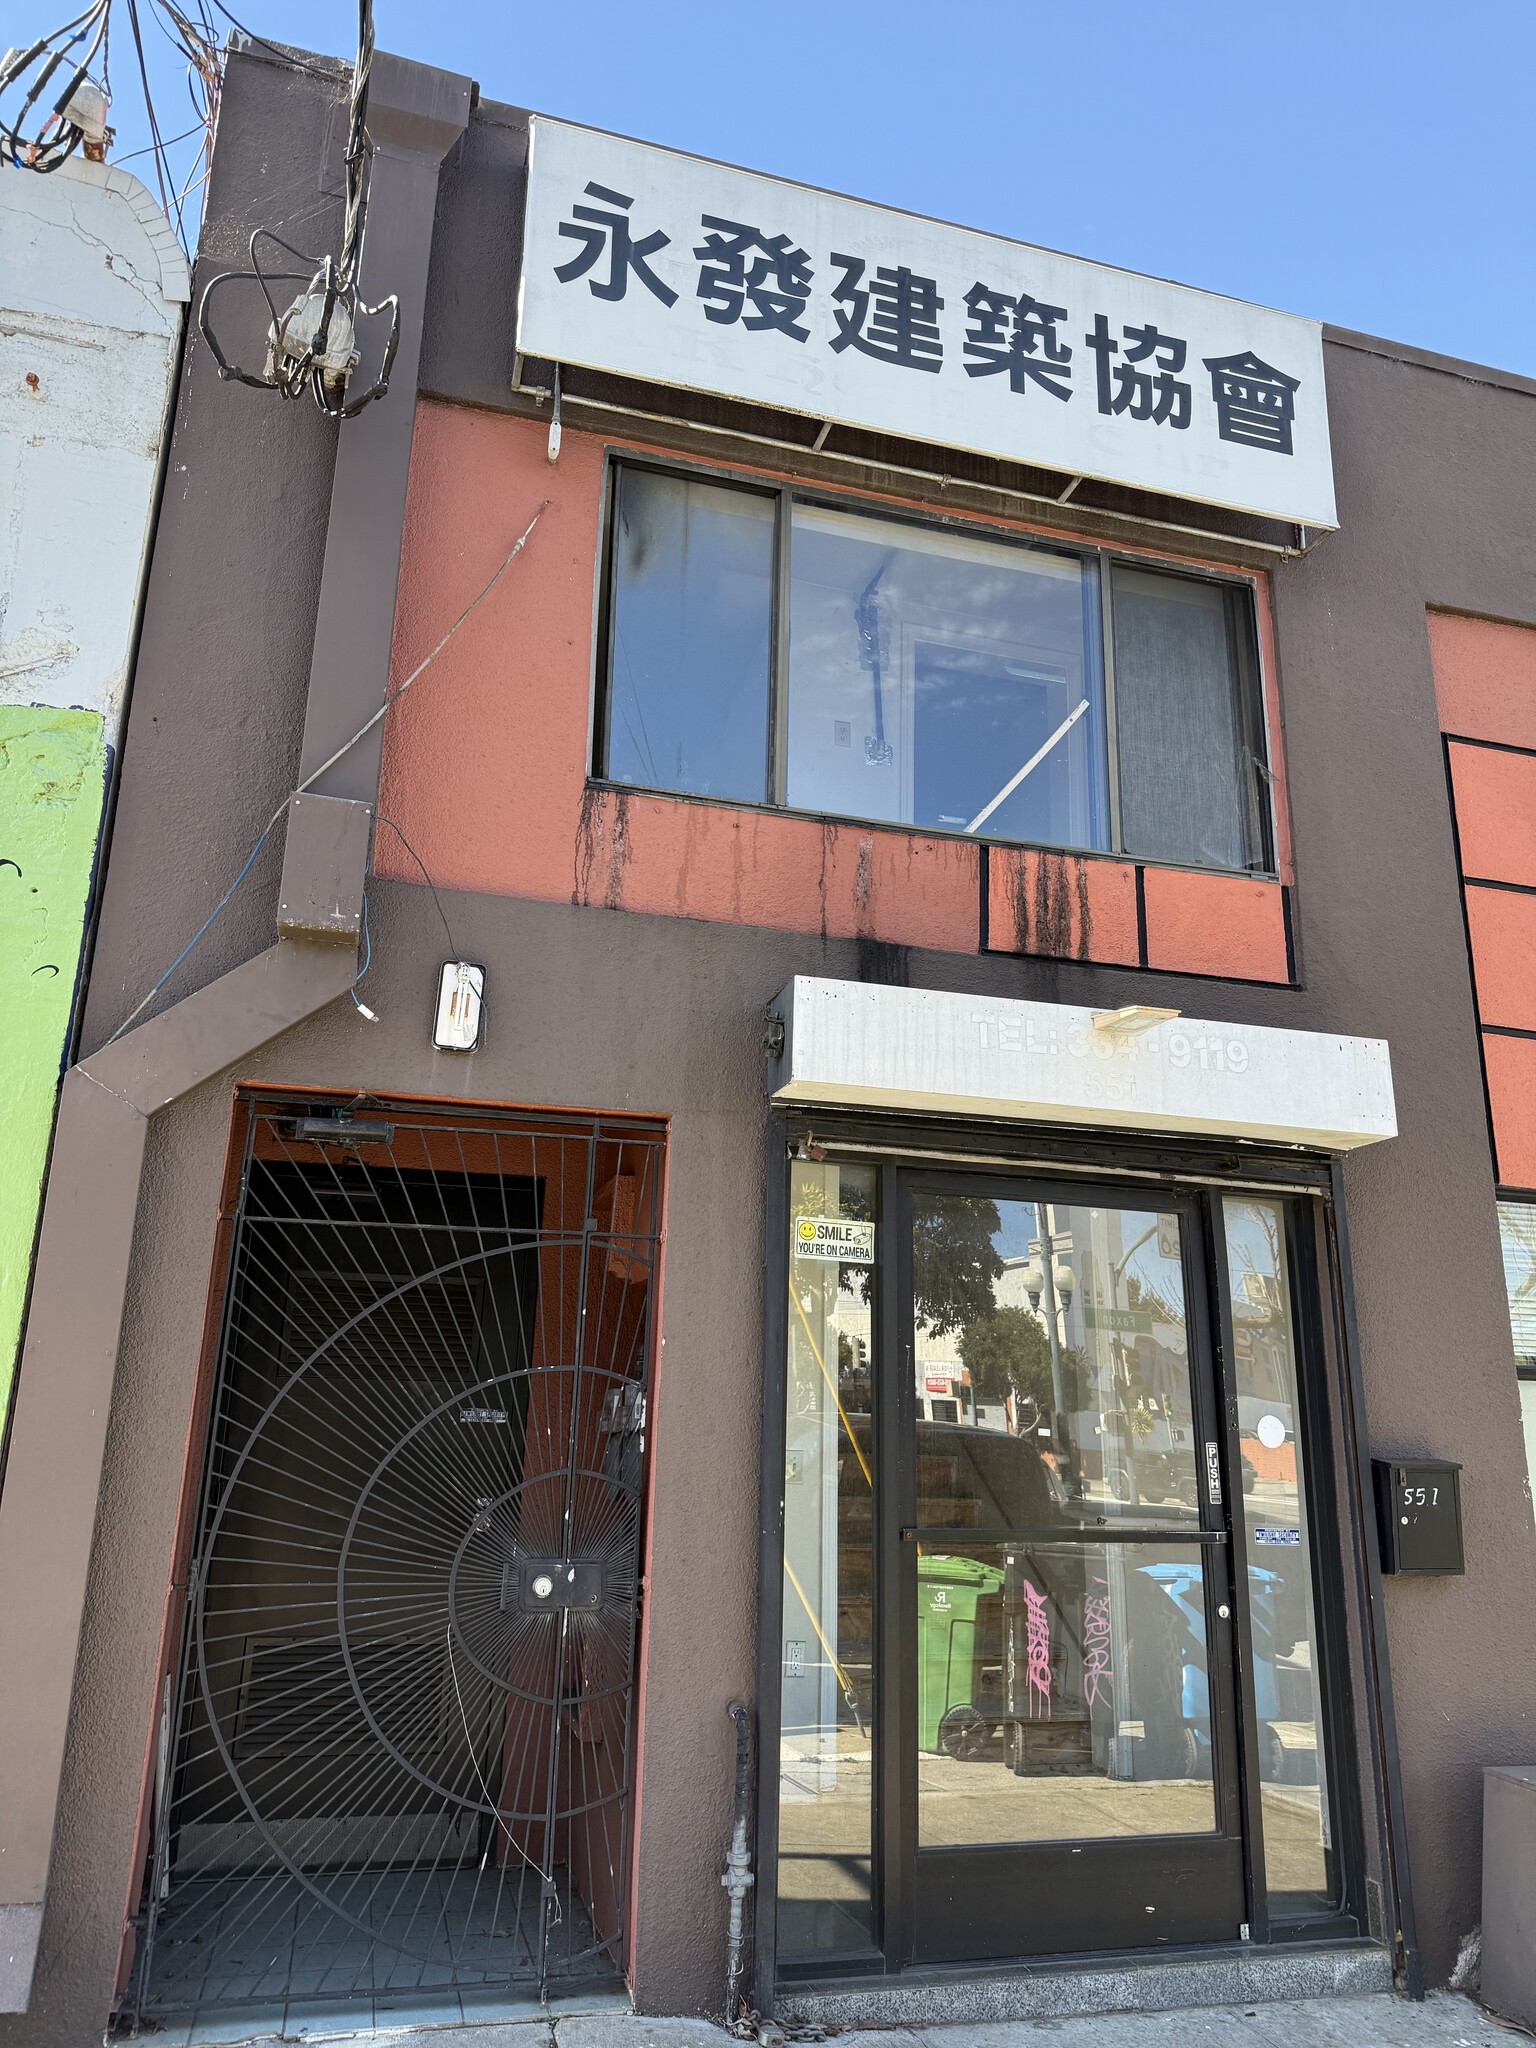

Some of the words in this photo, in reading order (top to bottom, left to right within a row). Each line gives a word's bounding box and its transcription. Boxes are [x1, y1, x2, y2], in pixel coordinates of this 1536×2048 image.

[553, 181, 1301, 456] 永發建築協會
[970, 1013, 1058, 1055] TEL:
[798, 1242, 826, 1255] YOU'RE
[826, 1244, 838, 1256] ON
[839, 1245, 871, 1258] CAMERA
[817, 1225, 853, 1242] SMILE
[1208, 1447, 1219, 1489] PUSH
